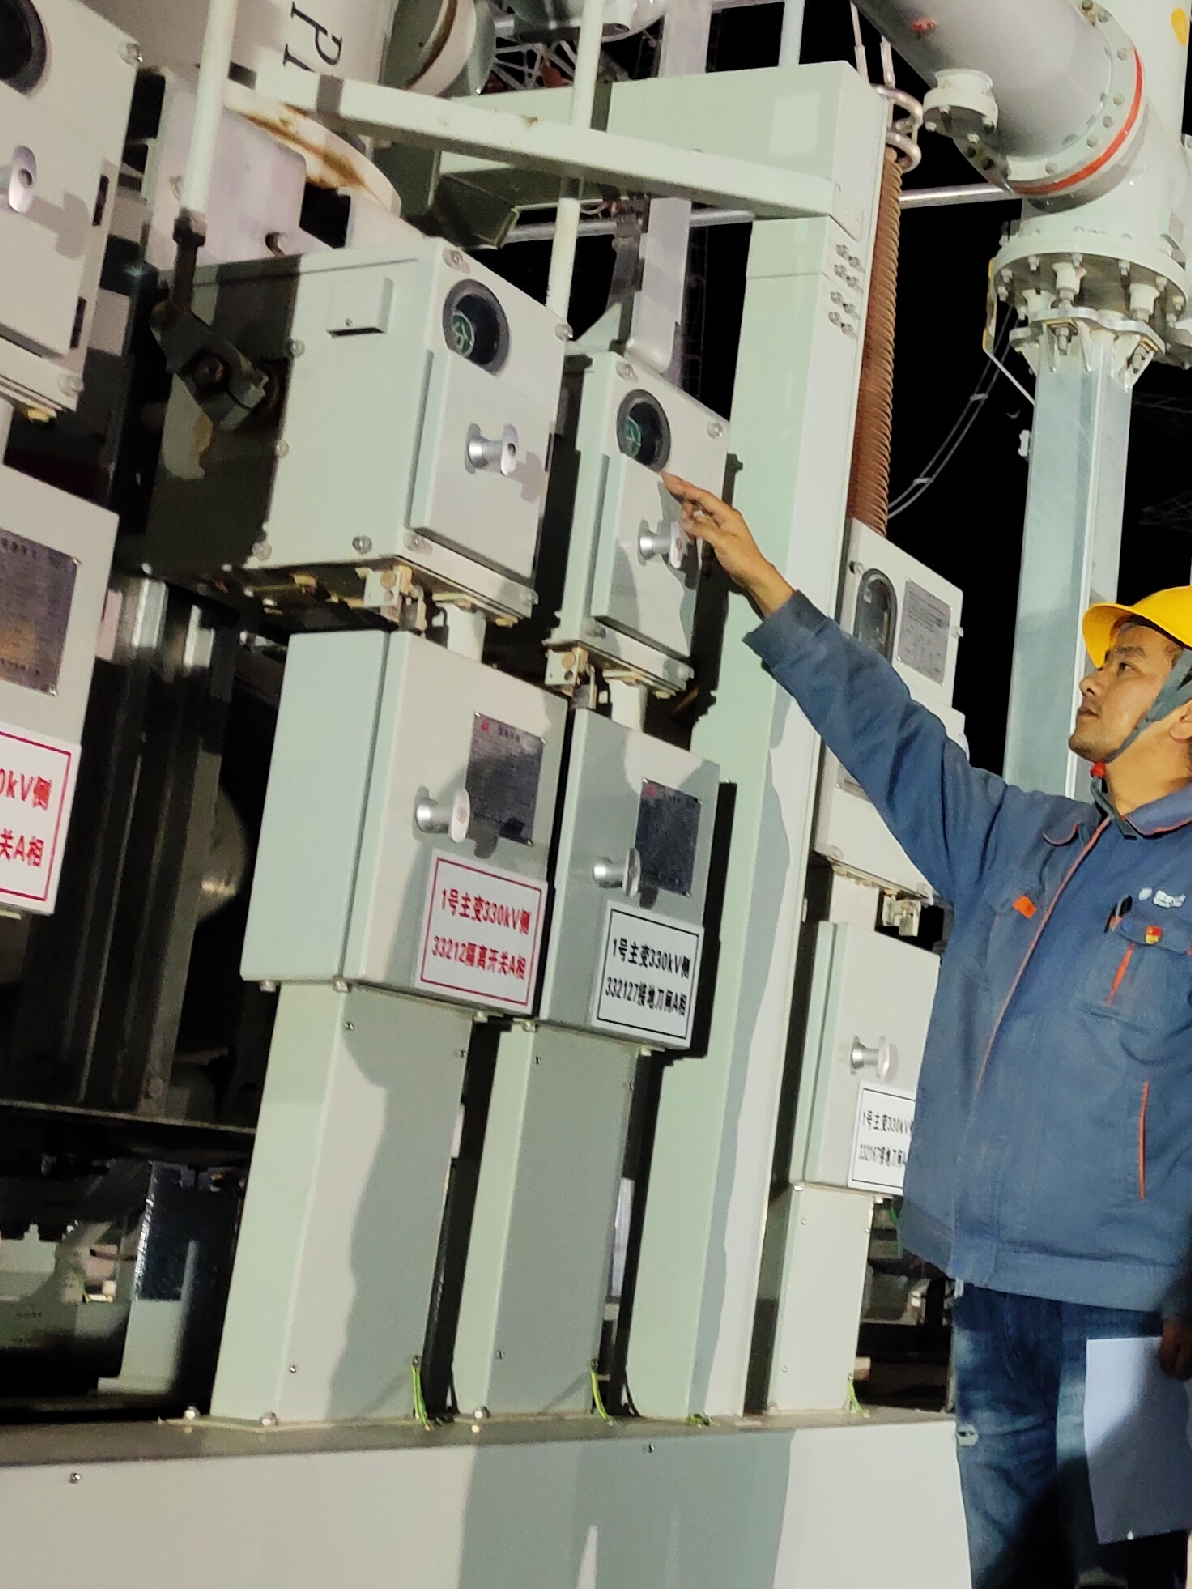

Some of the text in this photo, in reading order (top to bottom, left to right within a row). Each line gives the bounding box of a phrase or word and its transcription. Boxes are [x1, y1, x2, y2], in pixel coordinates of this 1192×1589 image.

[441, 887, 531, 935] 1号主变330kV侧
[431, 935, 527, 981] 33212隔离开关A相
[612, 937, 691, 979] 1号主变330kV侧
